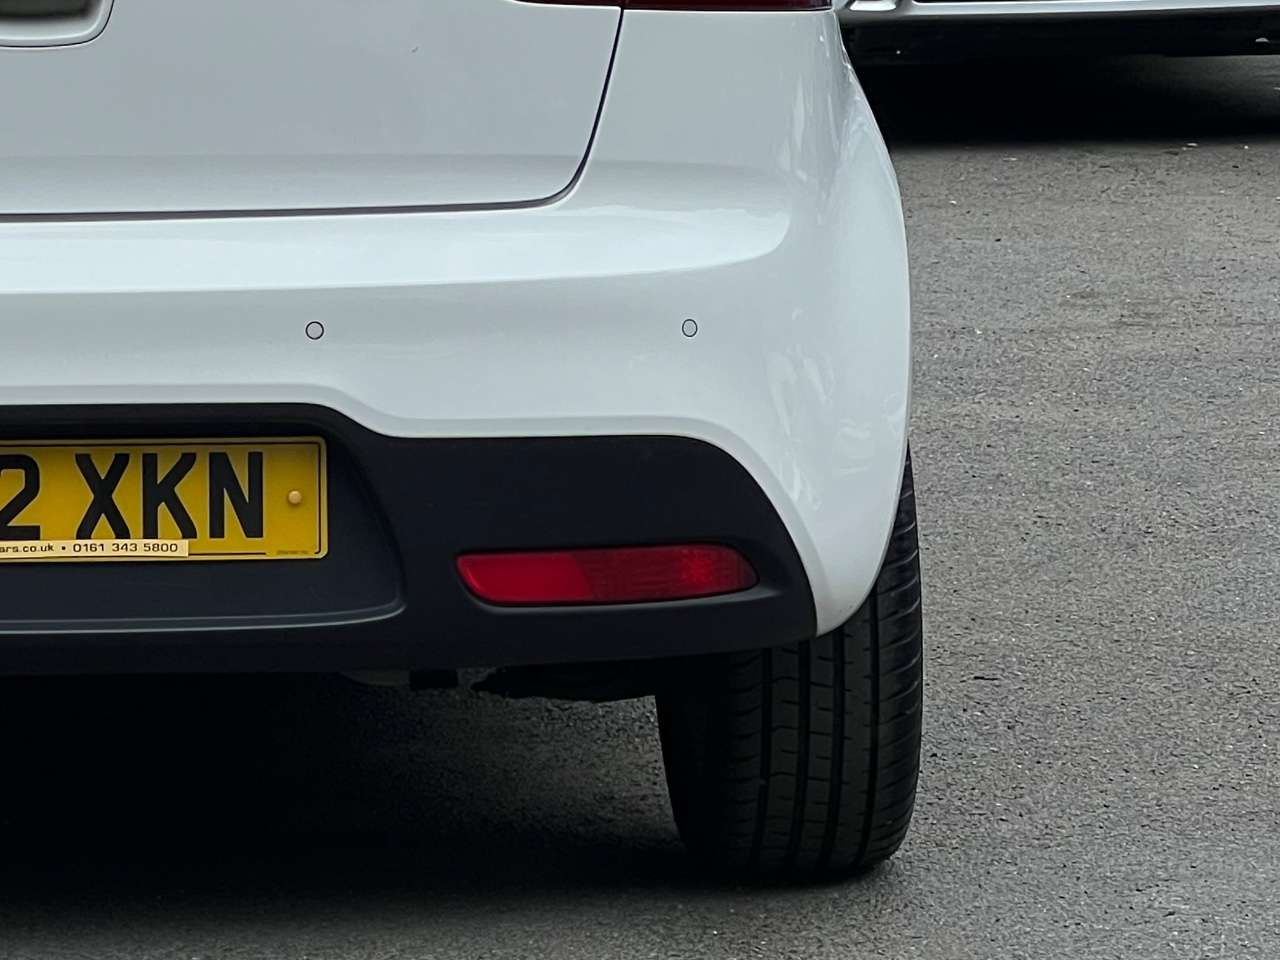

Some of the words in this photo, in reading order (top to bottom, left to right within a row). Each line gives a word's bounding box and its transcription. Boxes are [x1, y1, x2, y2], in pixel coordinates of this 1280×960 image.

[74, 451, 264, 540] XKN
[72, 543, 106, 553] 0161
[111, 543, 138, 553] 343
[143, 542, 178, 553] 5800
